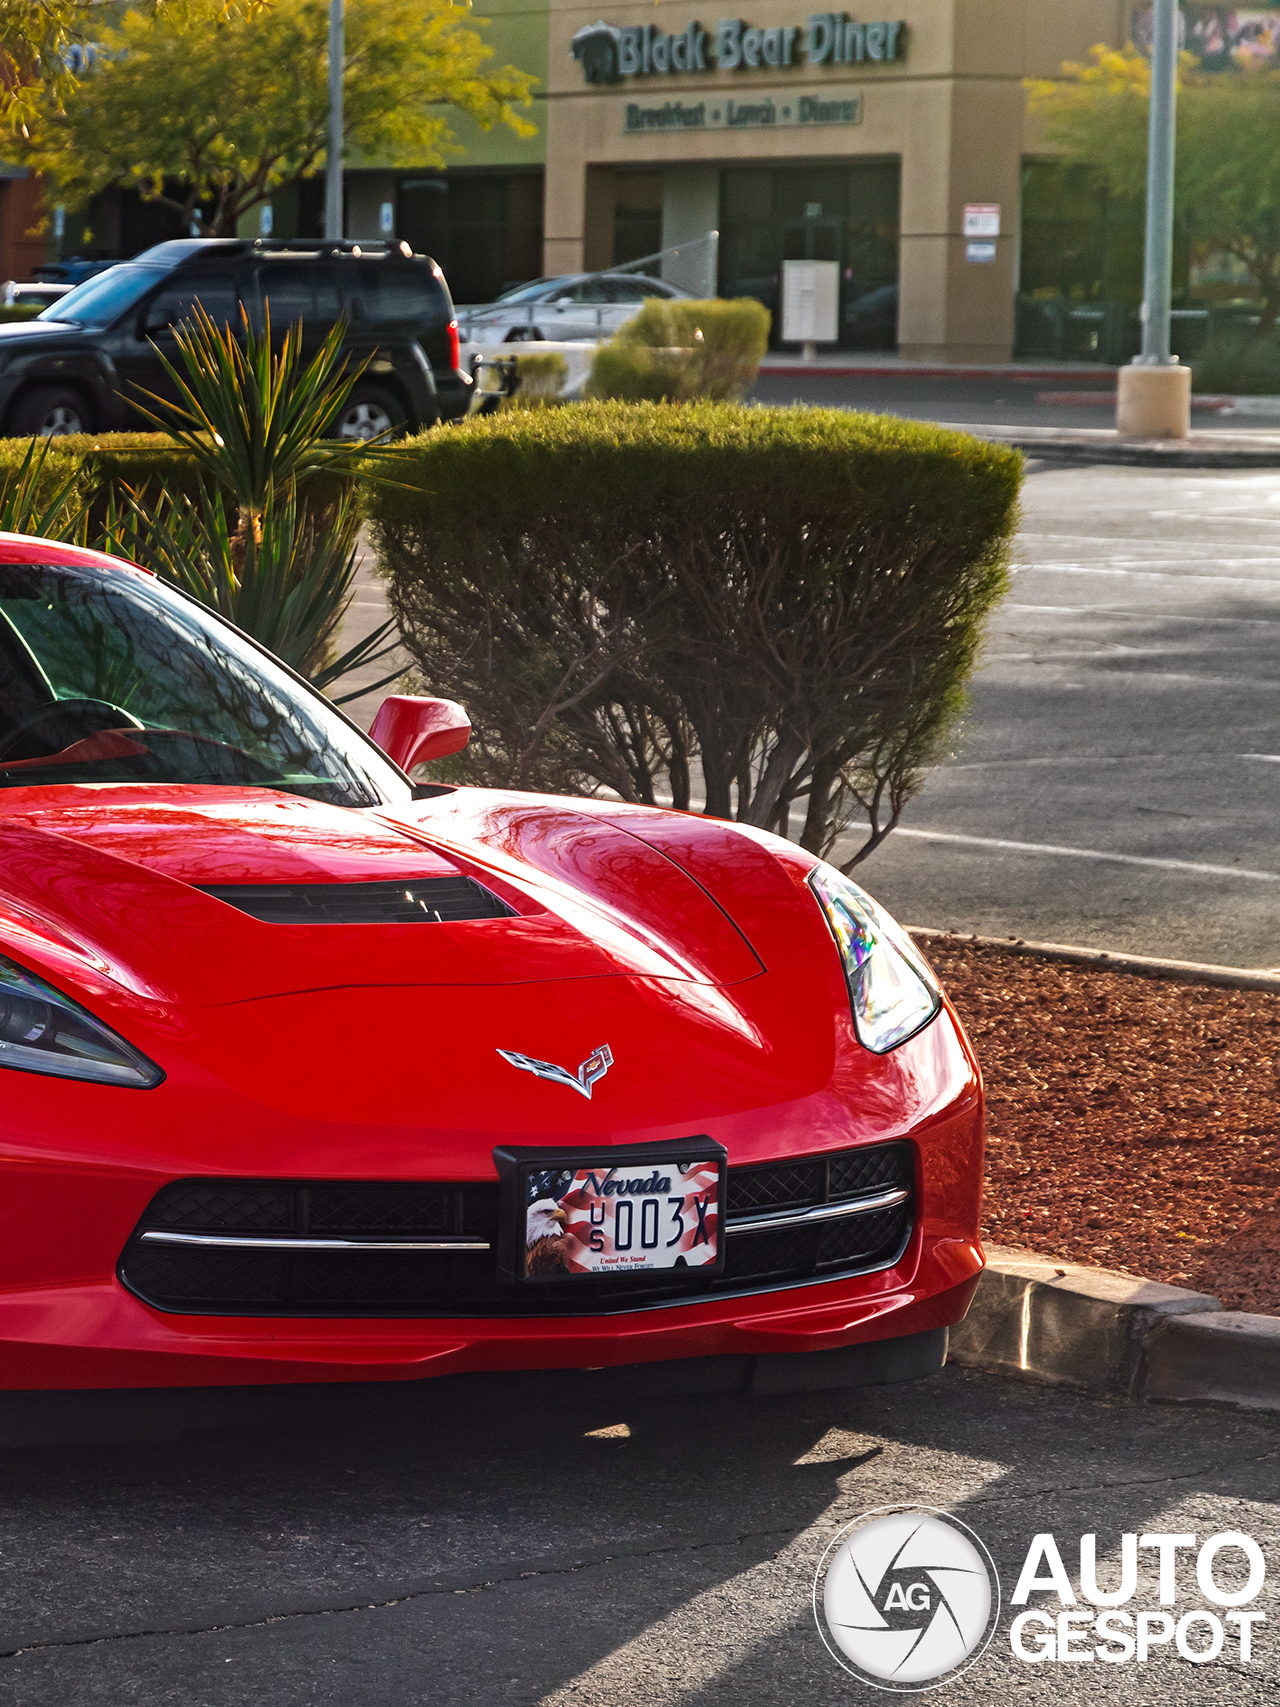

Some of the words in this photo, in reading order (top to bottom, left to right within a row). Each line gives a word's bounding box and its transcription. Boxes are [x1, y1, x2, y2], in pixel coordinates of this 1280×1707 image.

[620, 21, 706, 74] Black
[718, 18, 796, 68] Bear
[807, 12, 900, 63] Diner
[579, 1168, 671, 1196] Nevada
[600, 1256, 619, 1264] United
[630, 1255, 646, 1263] Stand
